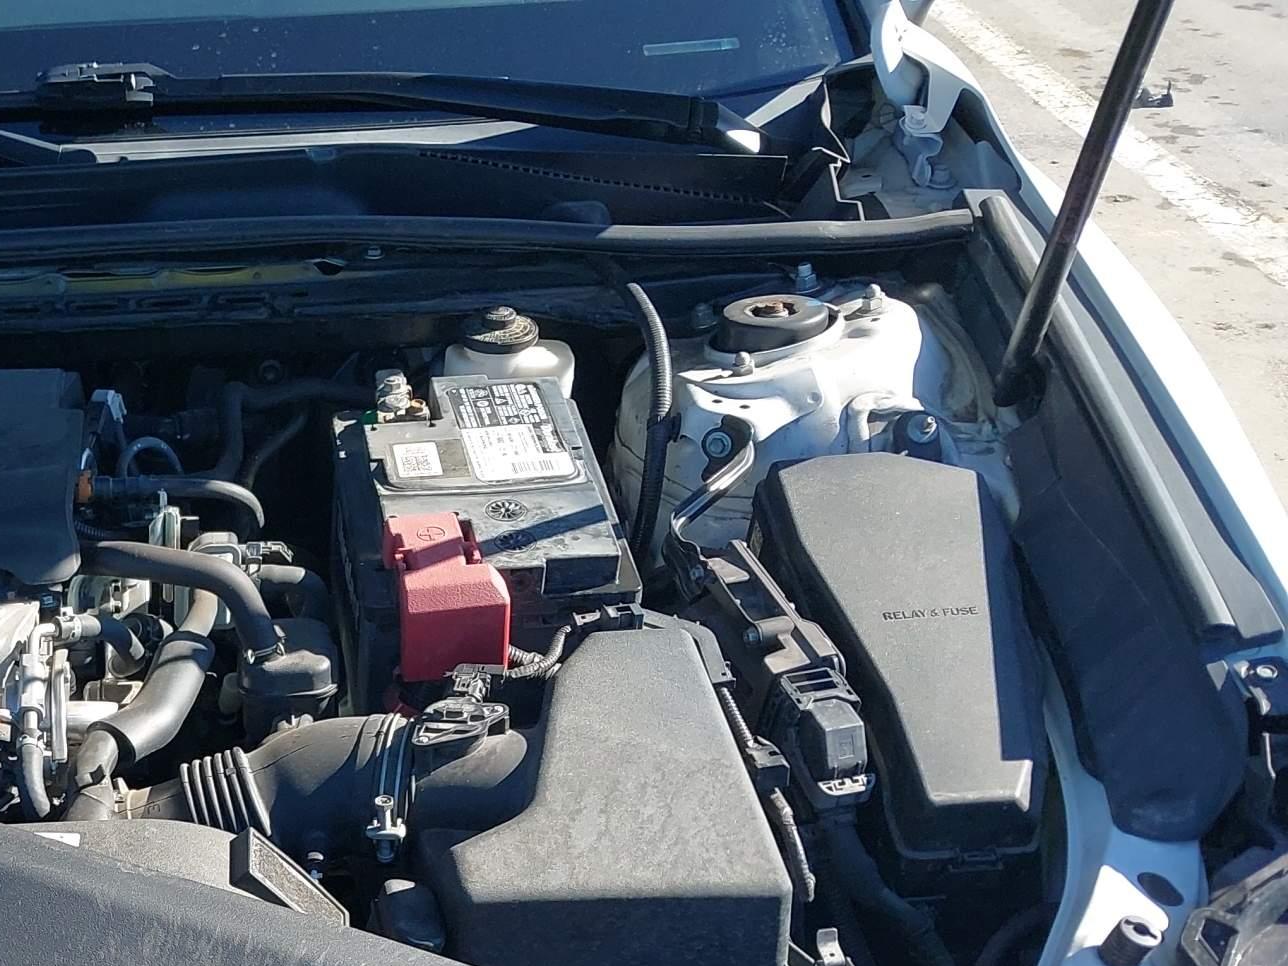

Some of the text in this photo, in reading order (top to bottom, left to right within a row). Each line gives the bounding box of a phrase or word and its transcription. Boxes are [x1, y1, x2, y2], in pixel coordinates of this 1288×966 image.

[882, 606, 978, 621] RELAY & FUSE
